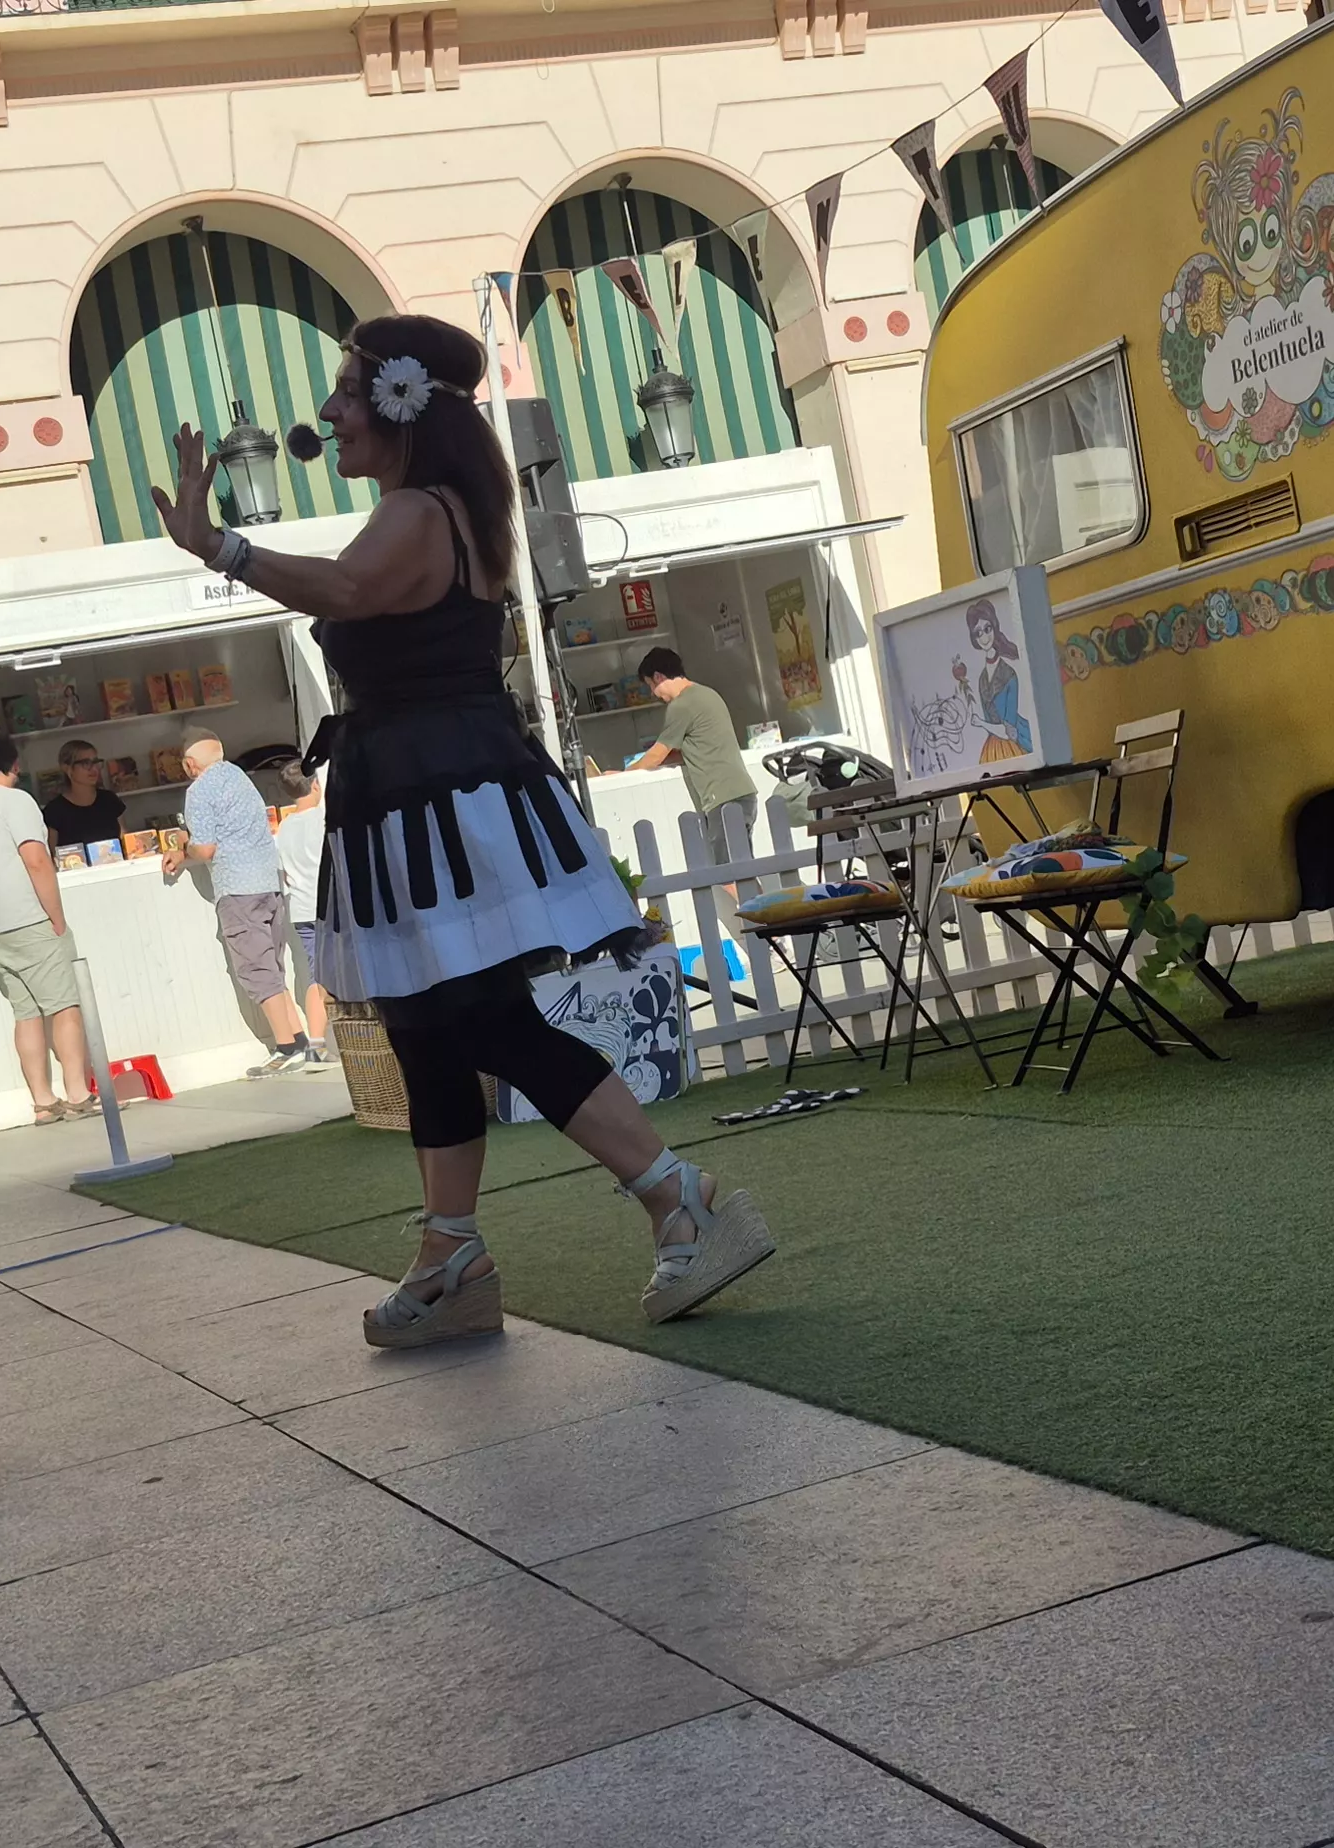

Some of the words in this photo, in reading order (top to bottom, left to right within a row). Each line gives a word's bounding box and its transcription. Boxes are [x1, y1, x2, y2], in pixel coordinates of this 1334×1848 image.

[1243, 329, 1252, 347] el
[1254, 317, 1288, 342] atelier
[1290, 309, 1303, 327] de
[1230, 324, 1325, 384] Belentuela
